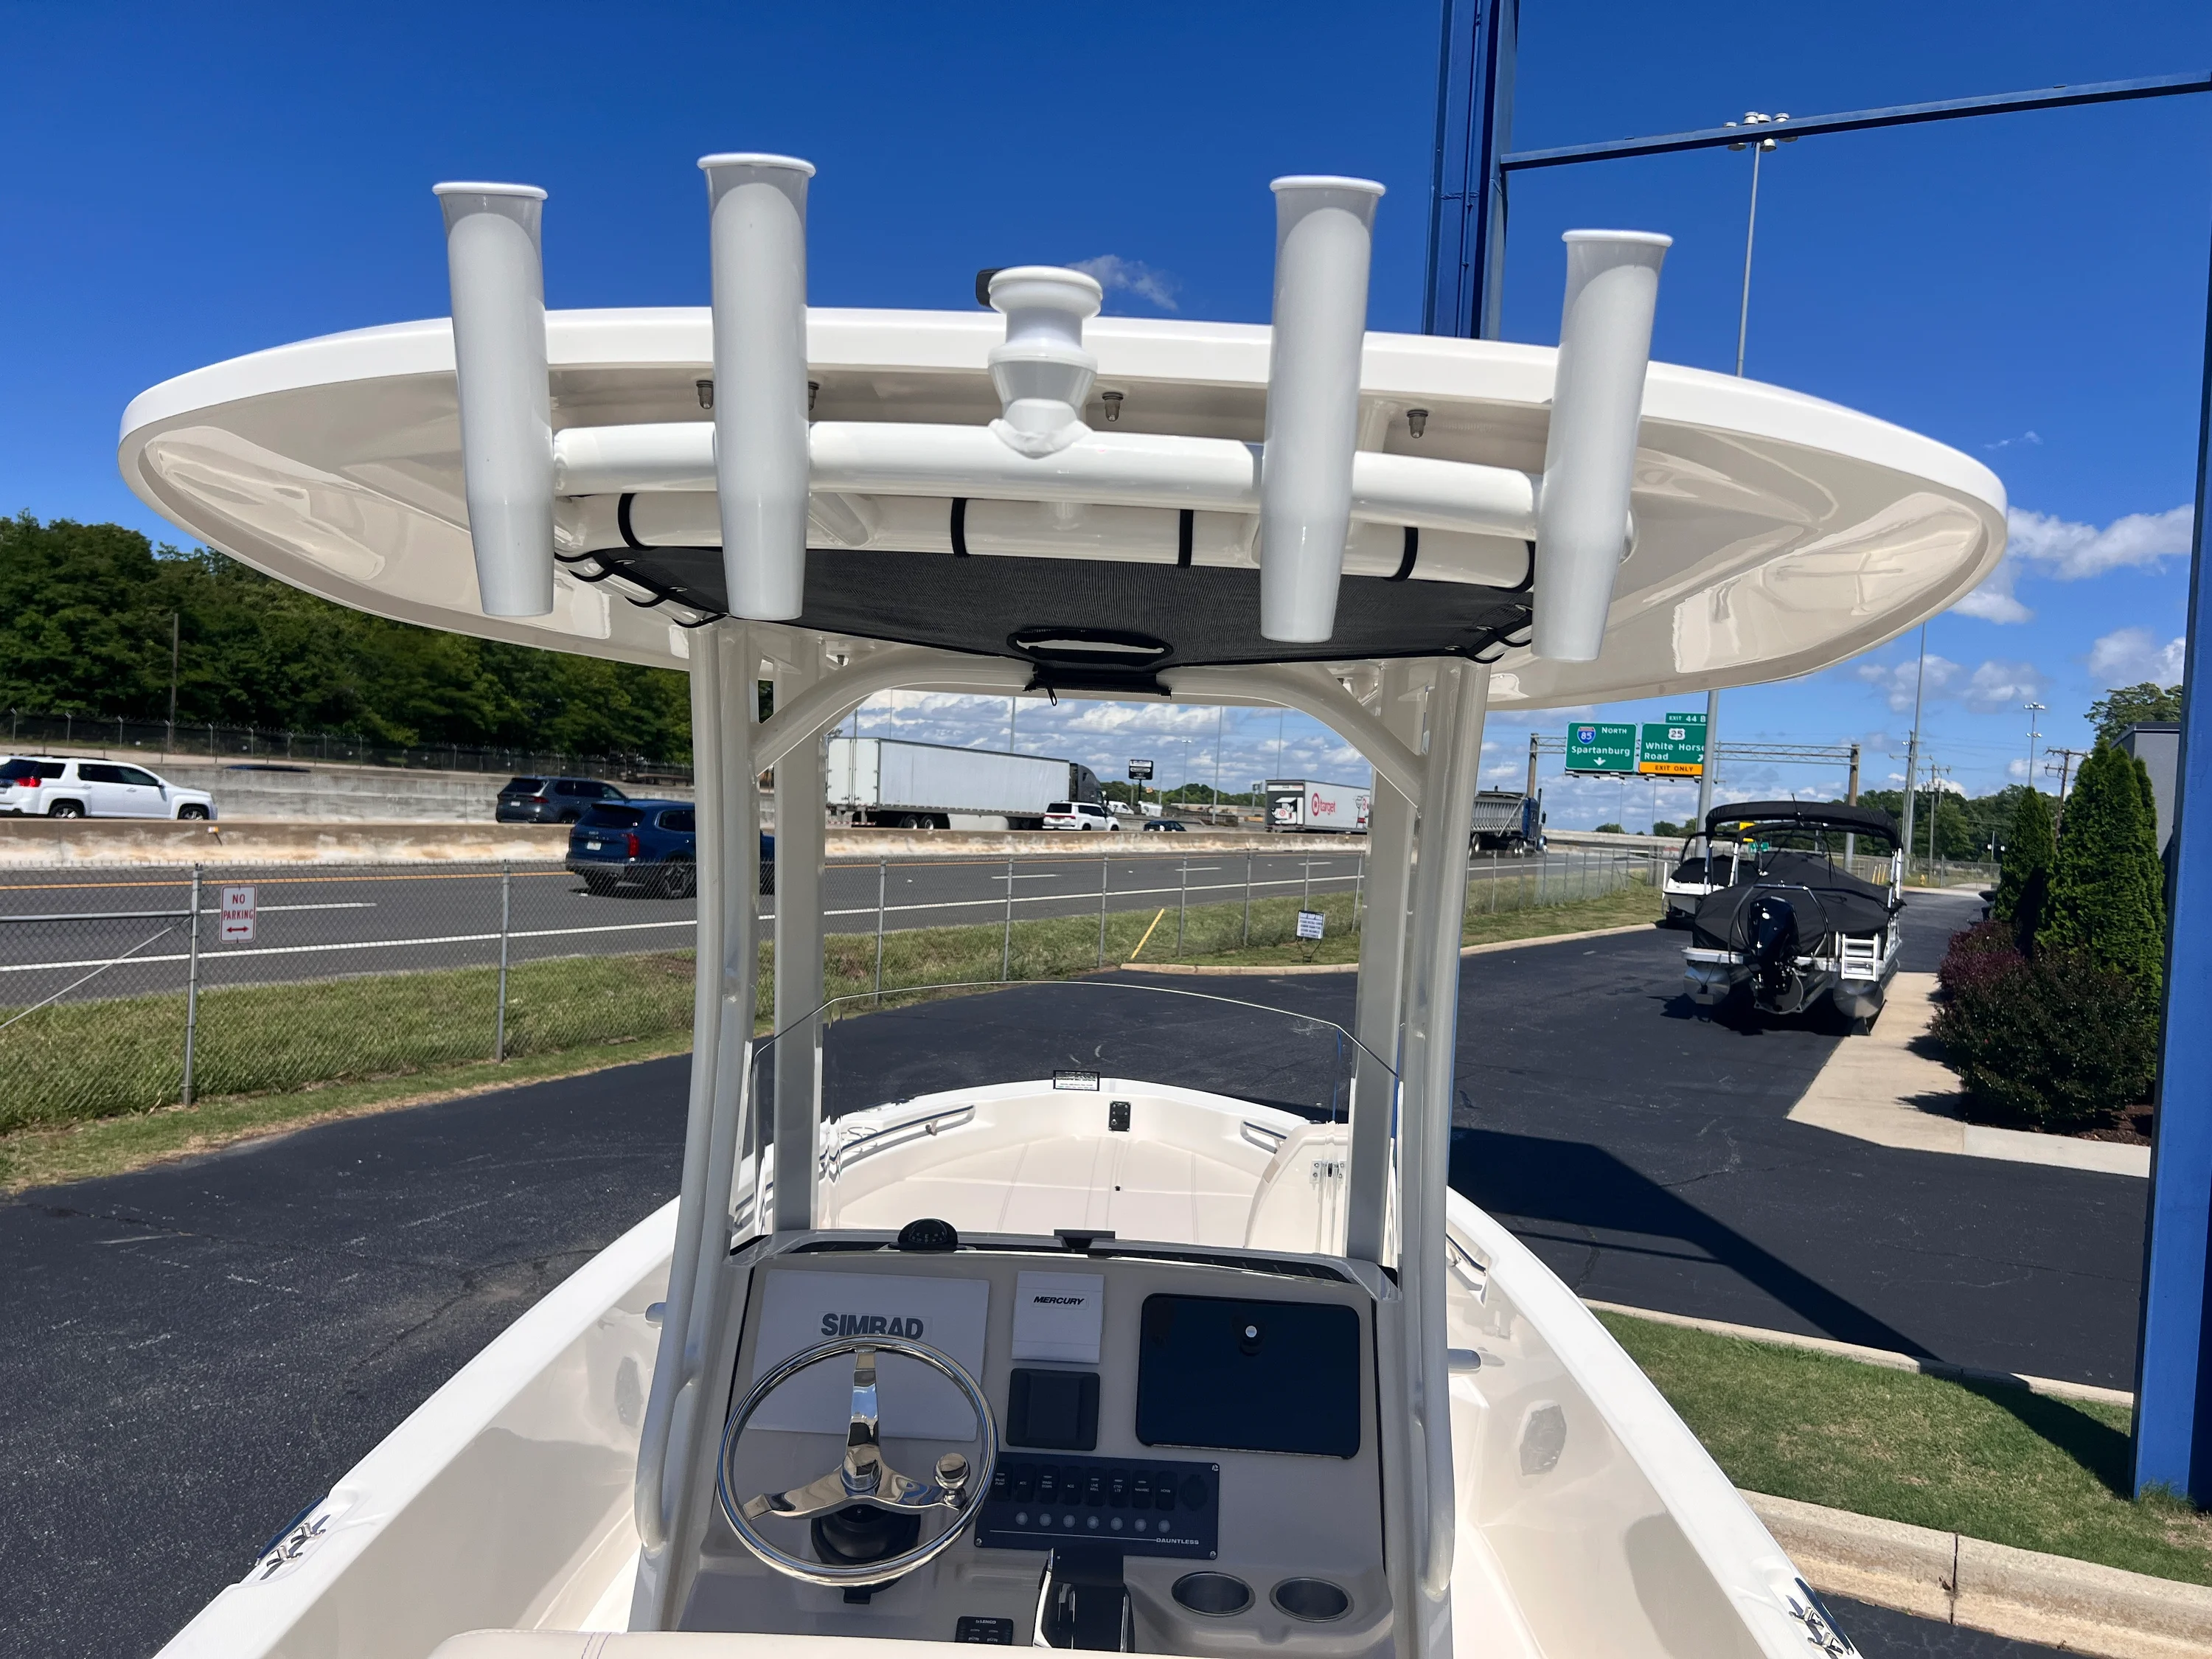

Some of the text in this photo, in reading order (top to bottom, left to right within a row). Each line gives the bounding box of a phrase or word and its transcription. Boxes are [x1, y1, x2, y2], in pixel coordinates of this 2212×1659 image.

[1601, 726, 1627, 734] NORTH
[1671, 730, 1683, 738] 25
[1581, 731, 1593, 740] 85
[1571, 745, 1630, 757] Spartanburg
[1645, 742, 1674, 751] White
[1644, 752, 1669, 760] Road
[1320, 799, 1336, 815] target
[232, 894, 246, 905] NO
[223, 909, 254, 920] PARKING
[1033, 1295, 1085, 1305] MERCURY
[821, 1313, 924, 1340] SIMRAD
